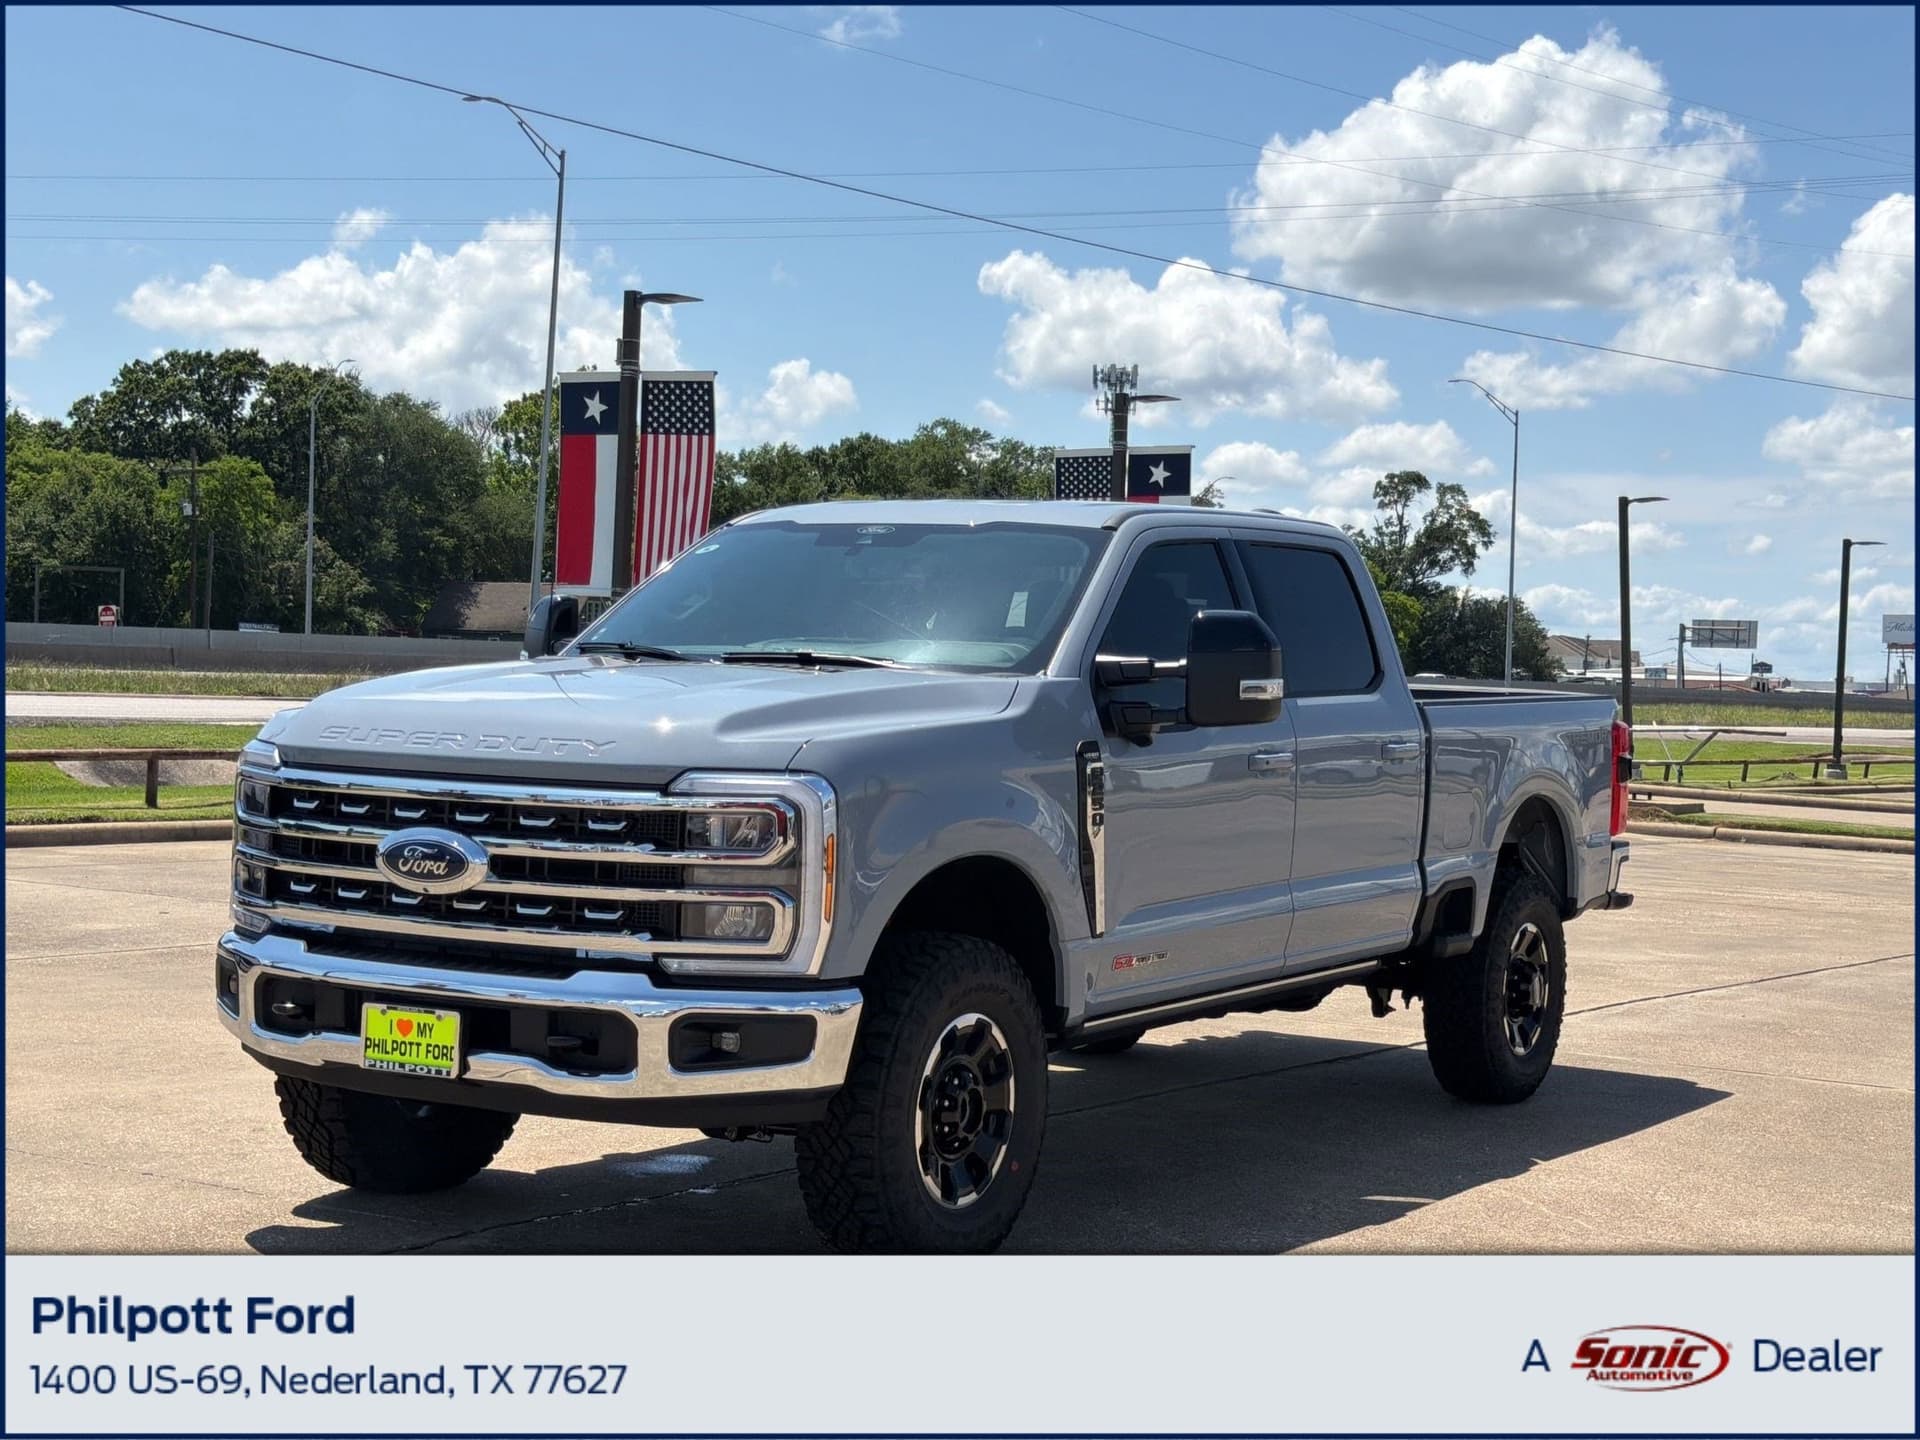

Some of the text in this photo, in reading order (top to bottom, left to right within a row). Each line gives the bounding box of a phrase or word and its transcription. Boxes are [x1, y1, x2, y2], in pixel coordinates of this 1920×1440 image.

[319, 725, 617, 757] SUPER DUTY
[398, 845, 450, 876] Ford
[389, 1018, 435, 1039] I MY
[365, 1037, 422, 1058] PHILPOTT
[364, 1059, 452, 1077] PHILPOTT
